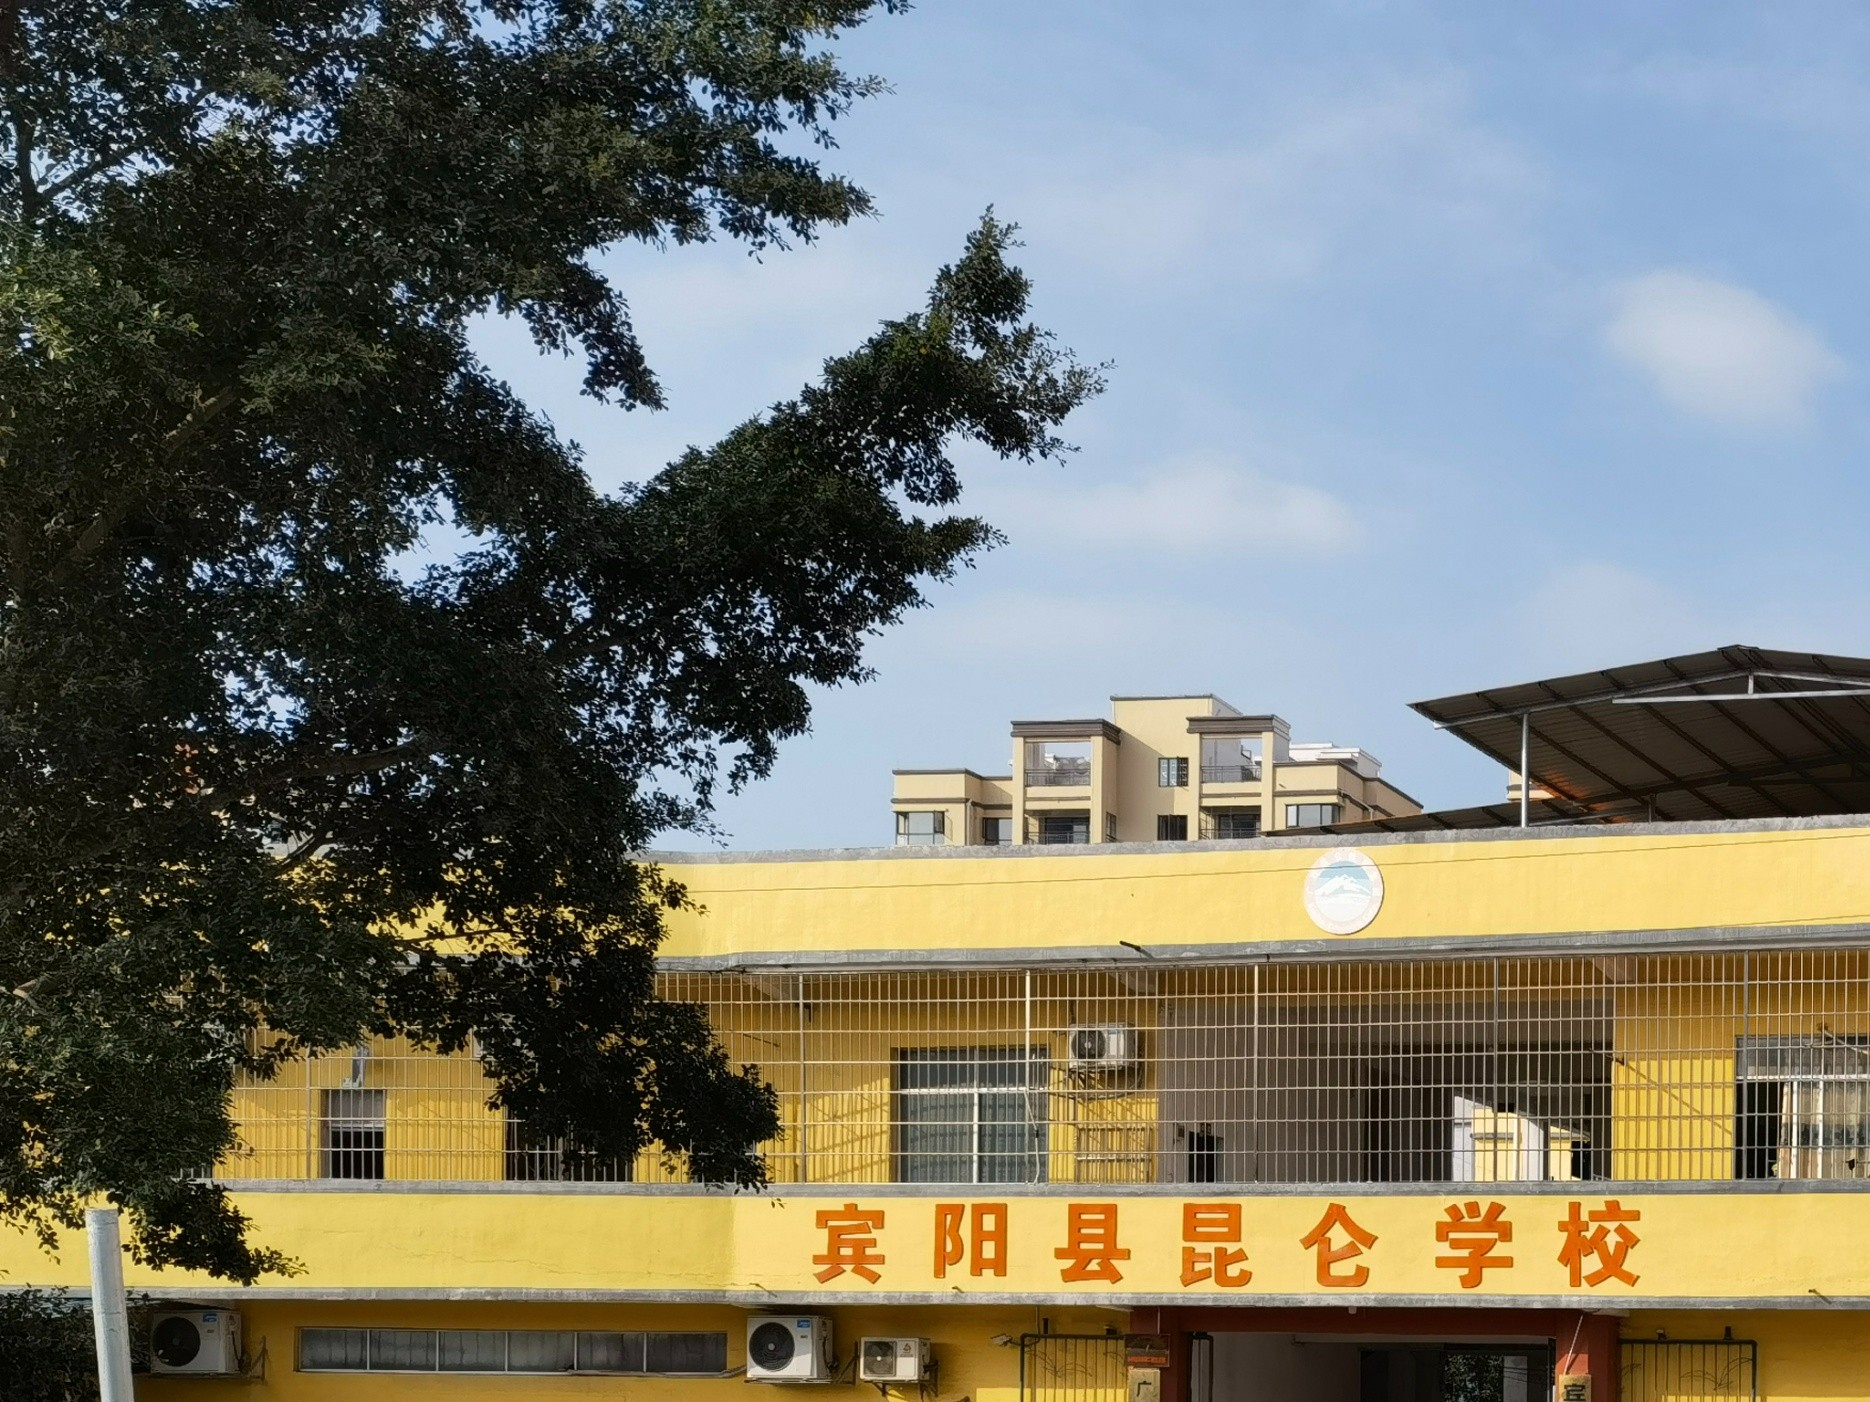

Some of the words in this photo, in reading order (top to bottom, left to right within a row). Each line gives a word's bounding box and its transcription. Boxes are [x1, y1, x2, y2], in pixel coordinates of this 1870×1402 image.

[812, 1200, 1641, 1288] 宾阳县昆仑学校
